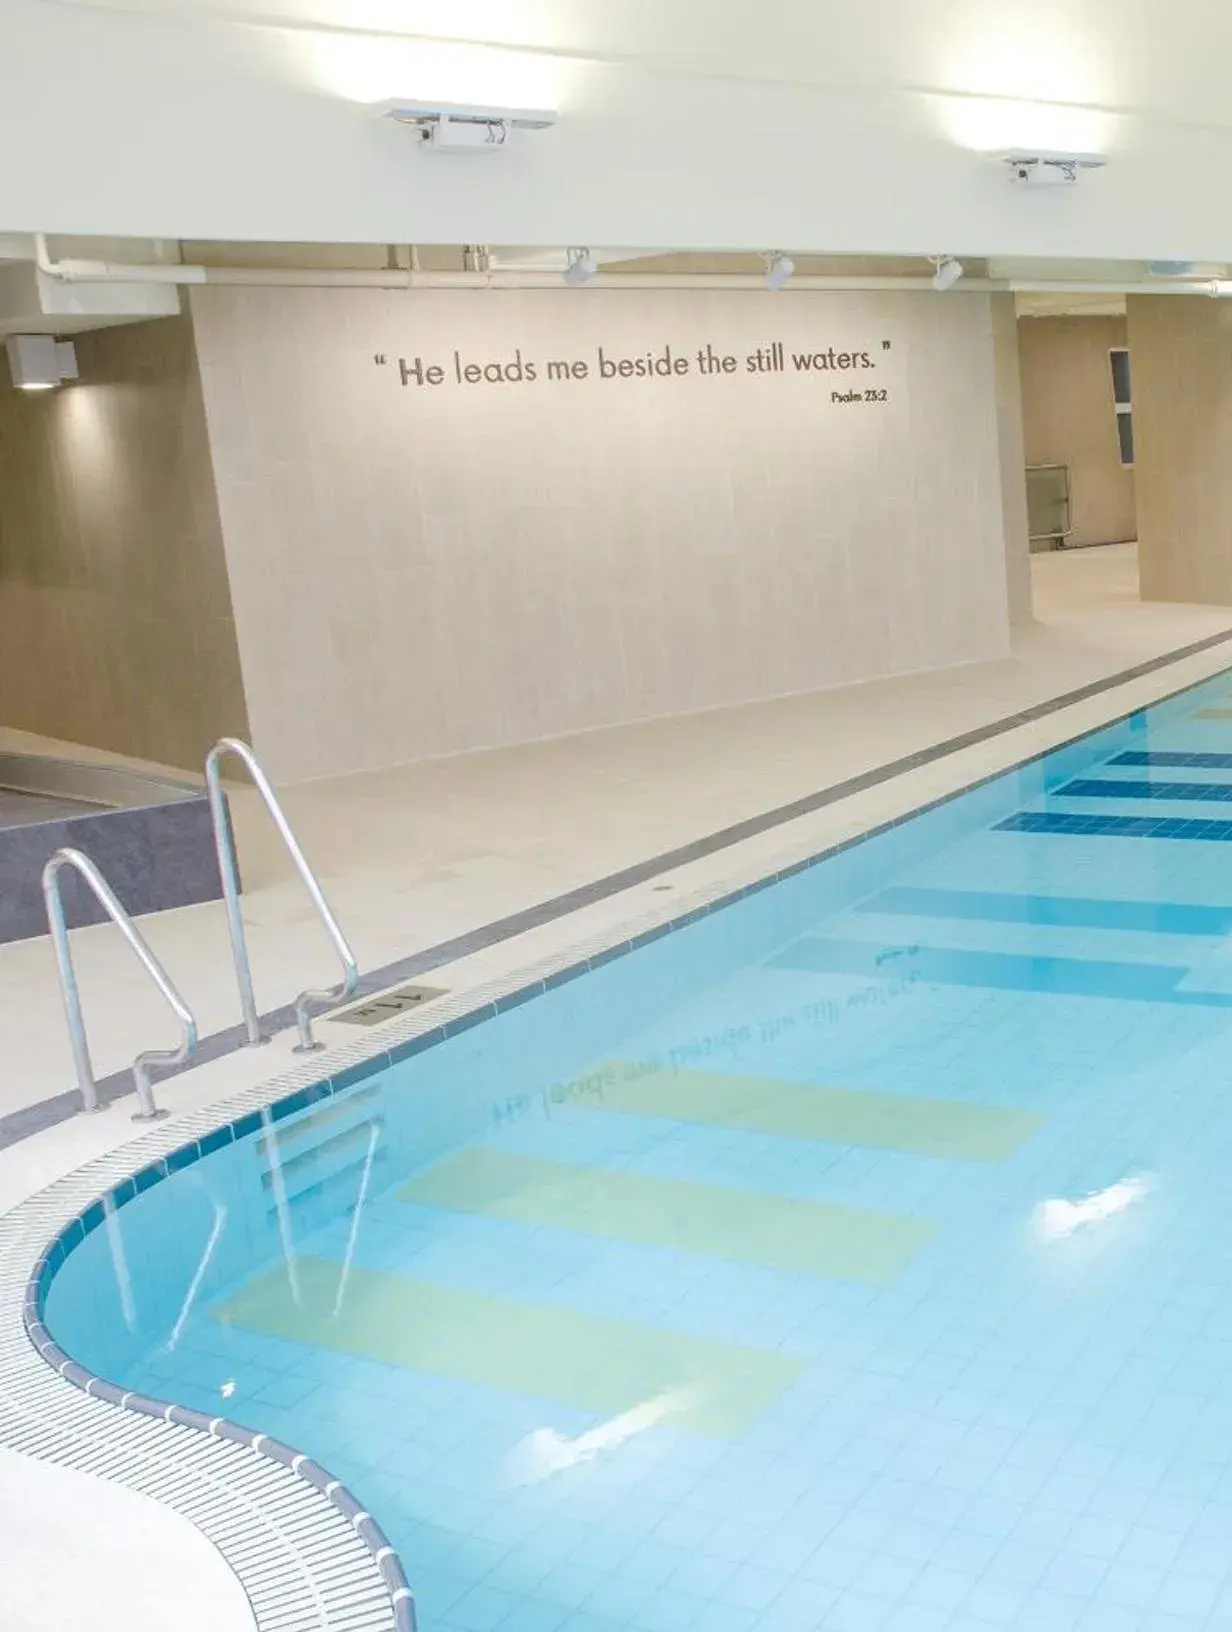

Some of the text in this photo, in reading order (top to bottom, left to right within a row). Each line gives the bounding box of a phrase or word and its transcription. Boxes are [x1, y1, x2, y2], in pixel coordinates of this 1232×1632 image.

[455, 349, 537, 384] leads
[547, 360, 589, 380] me
[598, 345, 688, 378] beside
[697, 344, 737, 374] the
[747, 341, 784, 373] still
[831, 388, 887, 403] Psalm 23:2
